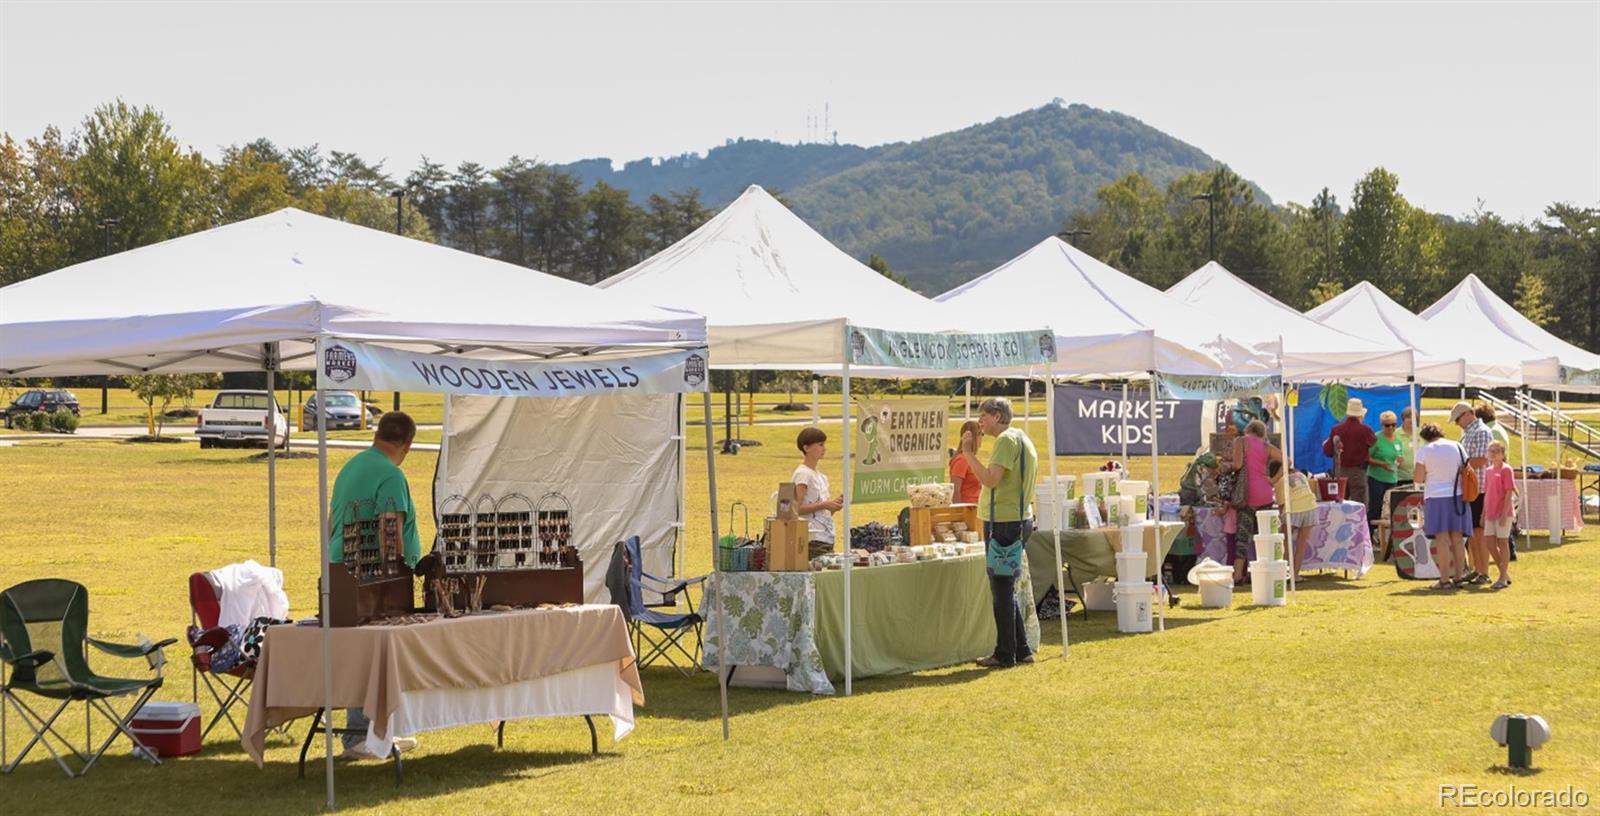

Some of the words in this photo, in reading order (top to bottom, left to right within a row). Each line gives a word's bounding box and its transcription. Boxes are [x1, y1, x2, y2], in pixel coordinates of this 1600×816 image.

[412, 361, 539, 391] WOODEN
[543, 366, 639, 390] JEWELS
[1078, 399, 1180, 419] MARKET
[890, 410, 944, 430] EARTHEN
[889, 432, 942, 452] ORGANICS
[1101, 425, 1153, 444] KIDS
[860, 478, 891, 495] WORM
